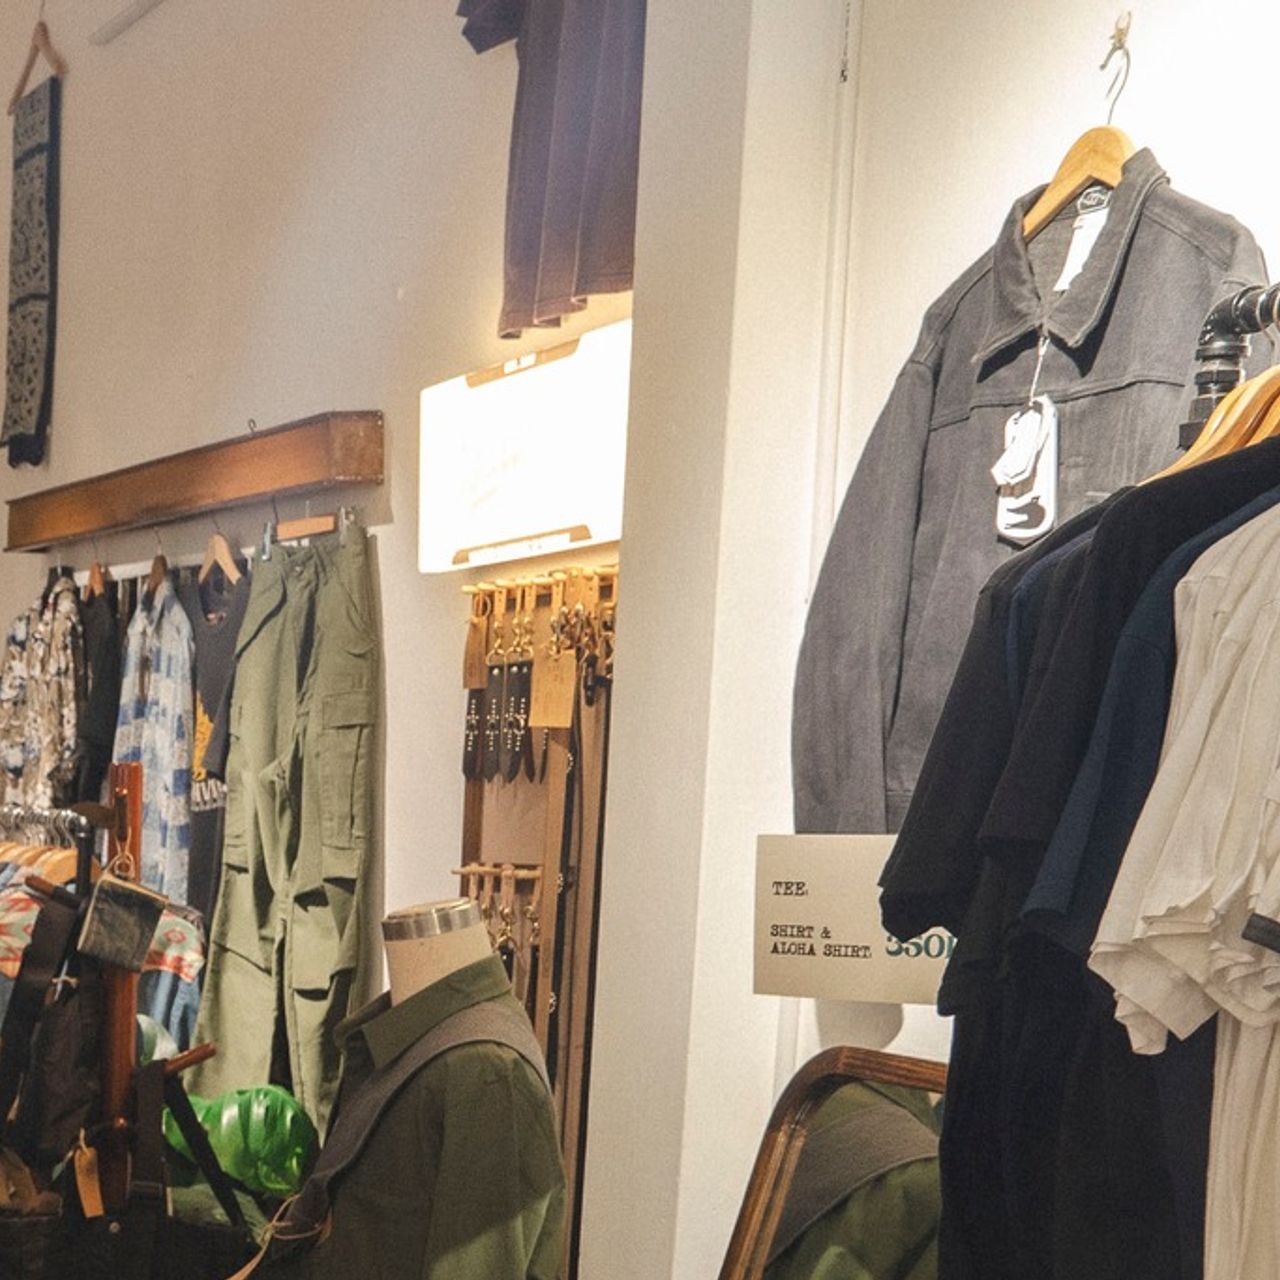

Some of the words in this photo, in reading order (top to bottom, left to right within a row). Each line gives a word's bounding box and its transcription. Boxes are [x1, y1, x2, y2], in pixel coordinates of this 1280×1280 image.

[770, 925, 815, 939] SHIRT
[820, 926, 832, 940] &
[770, 943, 816, 957] ALOHA
